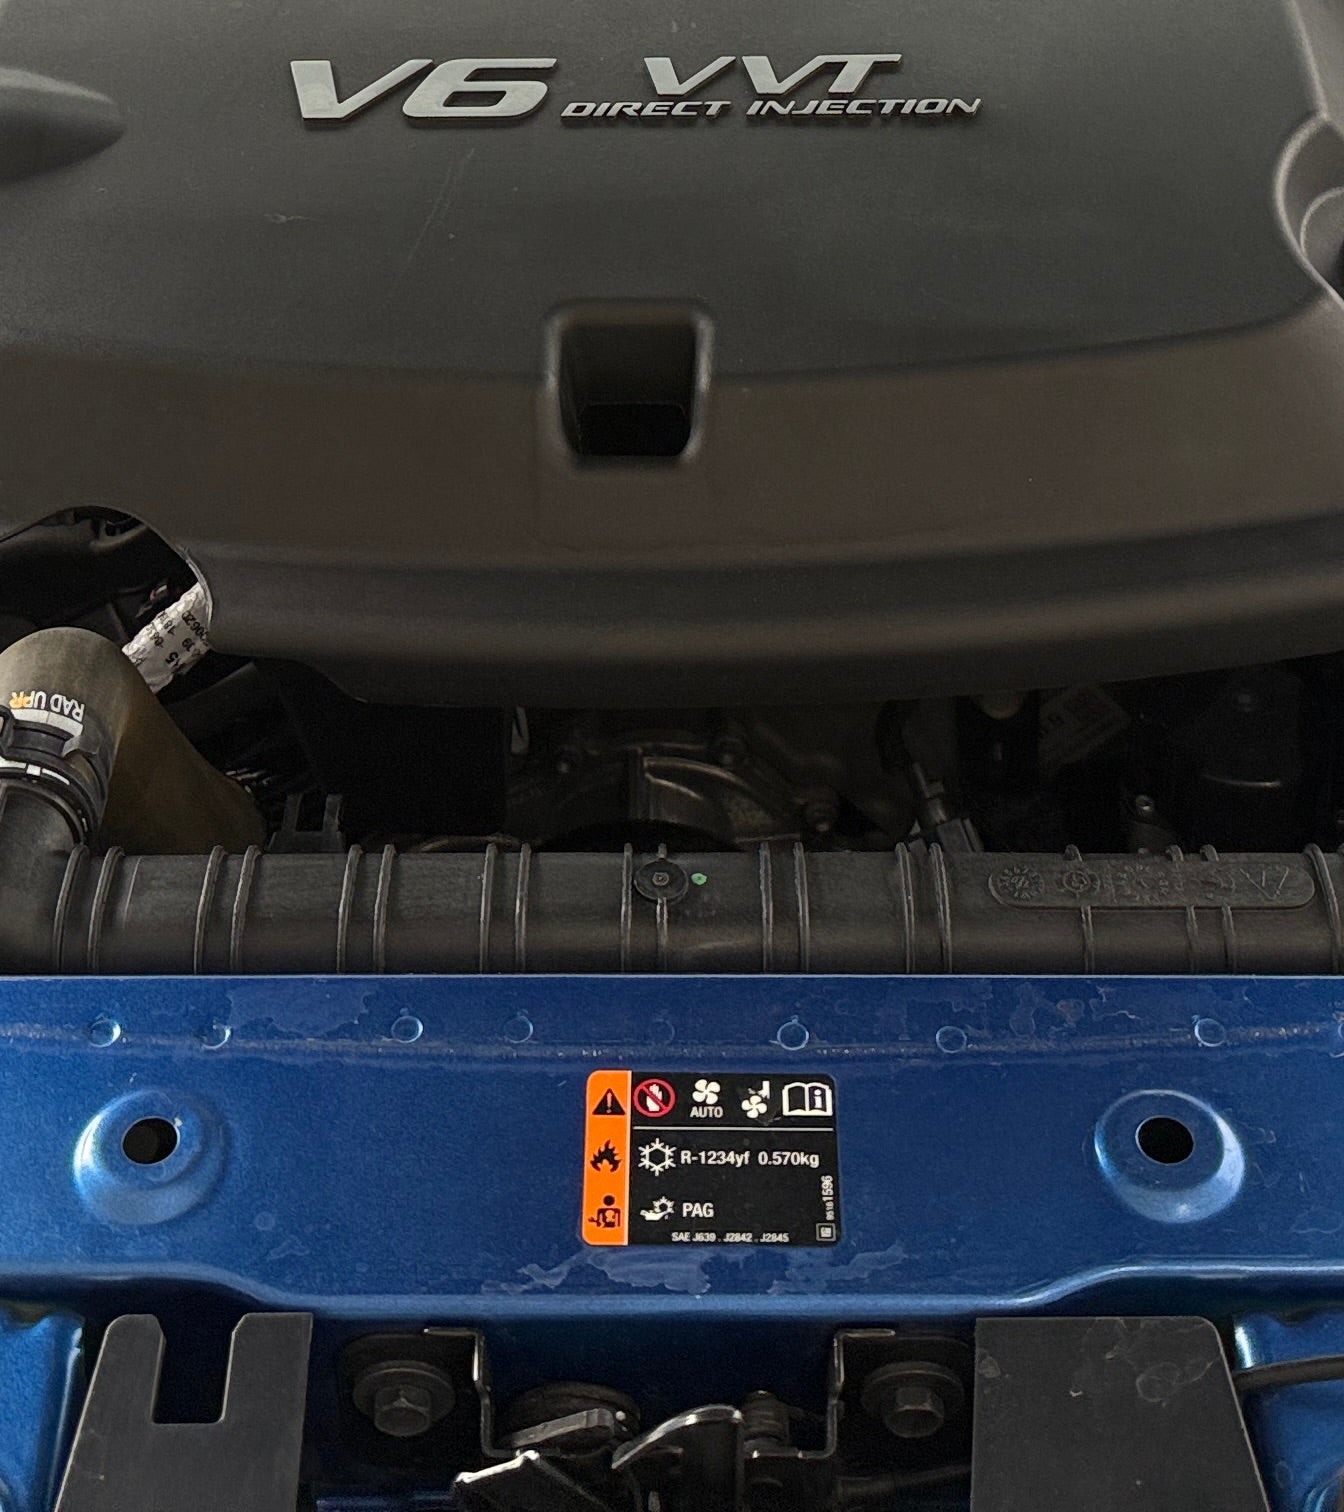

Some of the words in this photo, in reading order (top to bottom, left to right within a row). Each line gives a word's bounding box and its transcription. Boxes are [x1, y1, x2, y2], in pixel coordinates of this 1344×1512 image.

[290, 58, 557, 119] V6
[644, 53, 902, 95] VVT
[561, 100, 732, 118] DIRECT
[746, 98, 981, 117] INJECTION
[9, 690, 47, 710] UPR
[50, 693, 85, 723] RAD
[689, 1106, 723, 1119] AUTO
[680, 1150, 751, 1167] R-1234yf
[757, 1150, 820, 1168] 0.570kg
[682, 1202, 715, 1219] PAG
[671, 1231, 691, 1243] SAE
